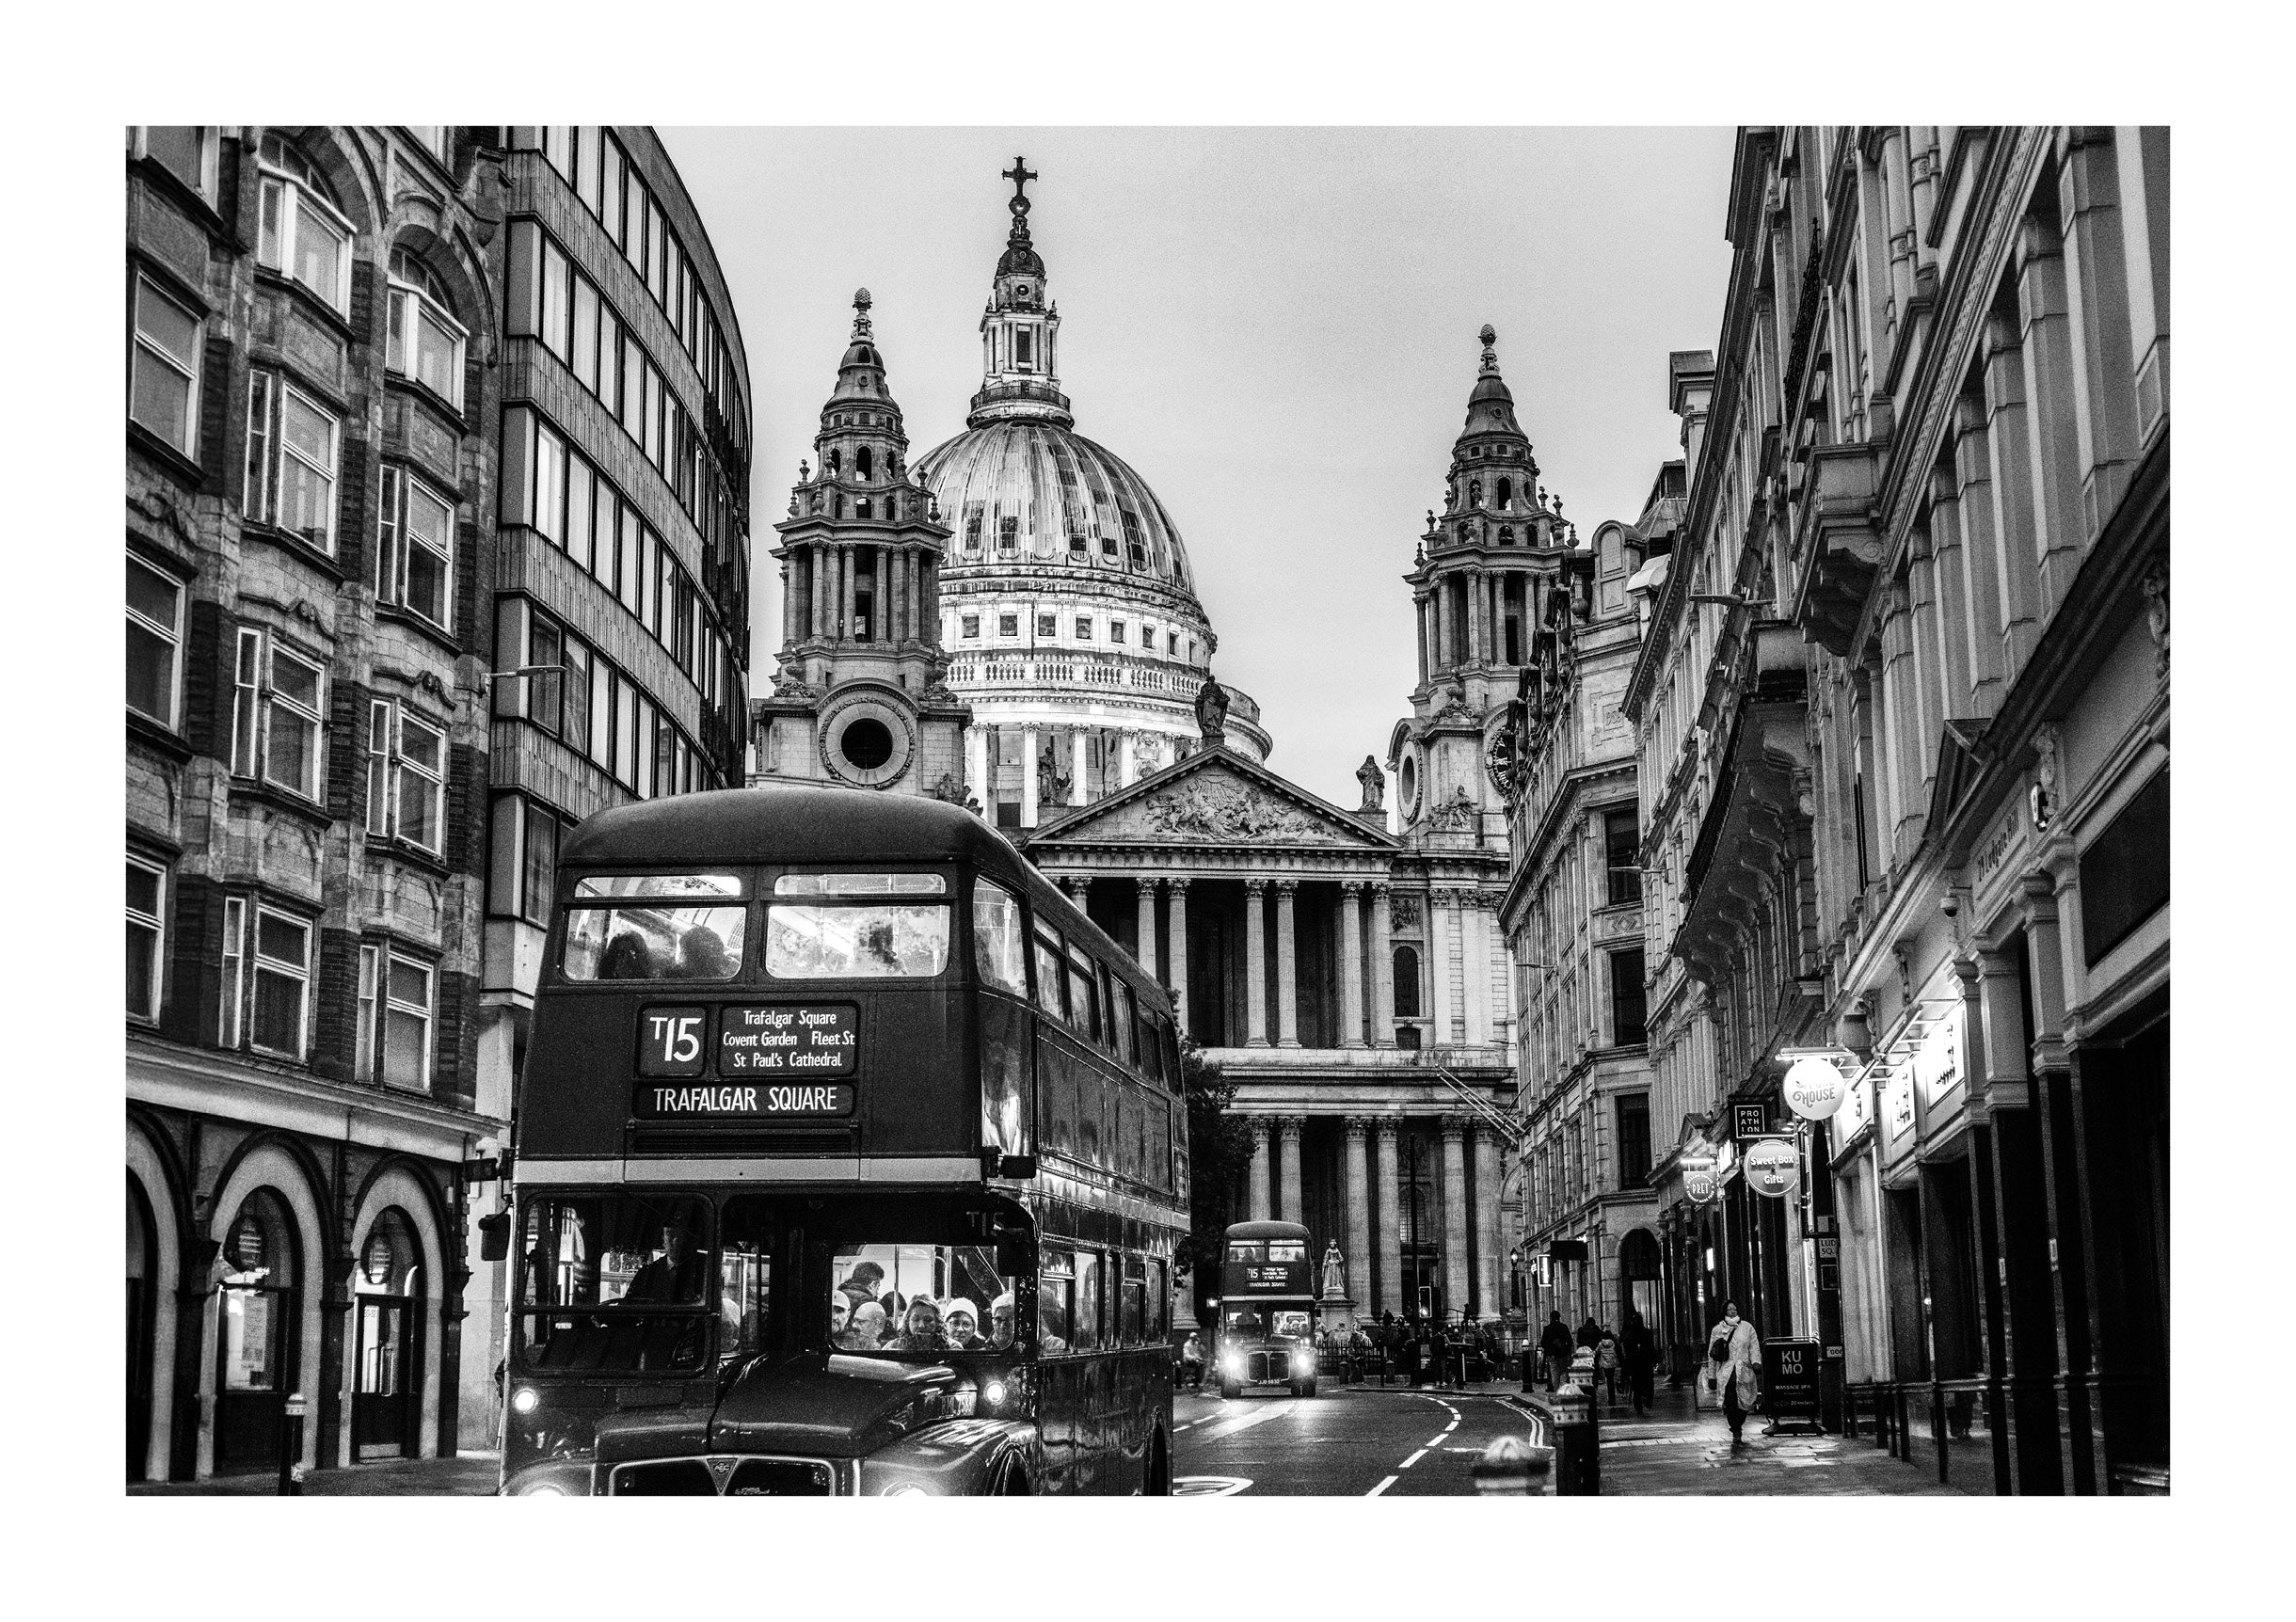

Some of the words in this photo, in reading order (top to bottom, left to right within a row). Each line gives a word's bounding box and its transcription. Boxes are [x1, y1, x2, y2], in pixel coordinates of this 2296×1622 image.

[743, 1010, 793, 1028] Trafalgar
[798, 1010, 837, 1028] Square
[649, 1017, 702, 1061] T15
[723, 1031, 758, 1046] Covent
[760, 1031, 798, 1046] Garden
[811, 1031, 840, 1045] Fleet
[841, 1030, 855, 1045] St
[733, 1053, 746, 1068] St
[753, 1052, 783, 1067] Paul's
[789, 1051, 842, 1067] Cathedral
[653, 1087, 757, 1111] TRAFALGAR
[767, 1087, 837, 1111] SQUARE
[1793, 1087, 1836, 1108] HOUSE
[1750, 1156, 1777, 1166] Sweet
[1778, 1155, 1794, 1164] Box
[1763, 1174, 1784, 1185] Gifts
[1692, 1183, 1709, 1194] PRET
[1247, 1268, 1258, 1279] T15
[1781, 1350, 1802, 1363] KU
[1781, 1363, 1803, 1375] MO
